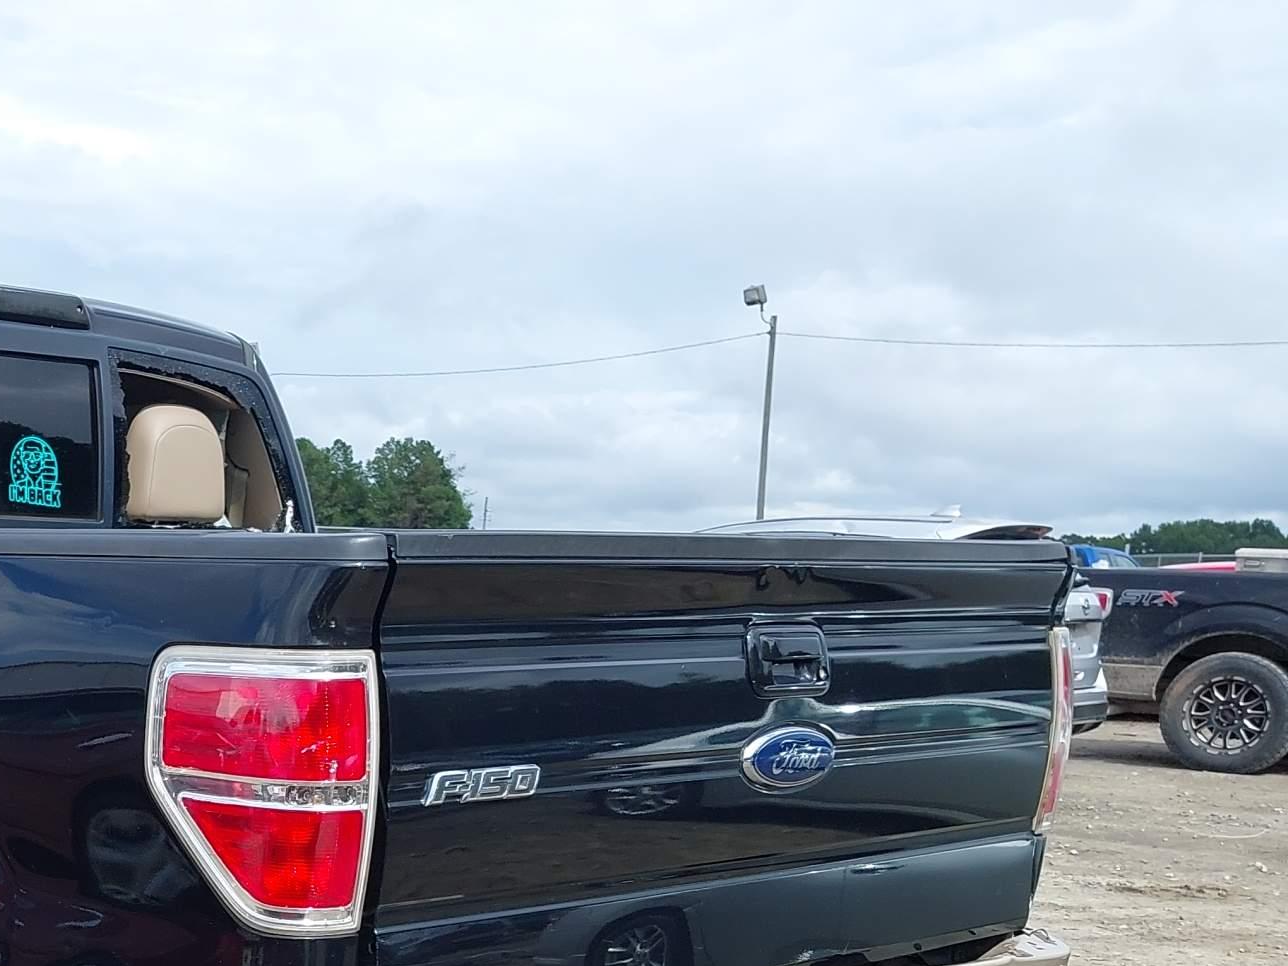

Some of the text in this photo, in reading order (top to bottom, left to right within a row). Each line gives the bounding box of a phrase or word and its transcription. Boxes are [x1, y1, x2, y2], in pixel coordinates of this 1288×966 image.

[8, 484, 61, 508] I'M BACK
[1115, 588, 1185, 607] STX
[772, 739, 827, 775] Ford
[420, 764, 541, 807] F-150
